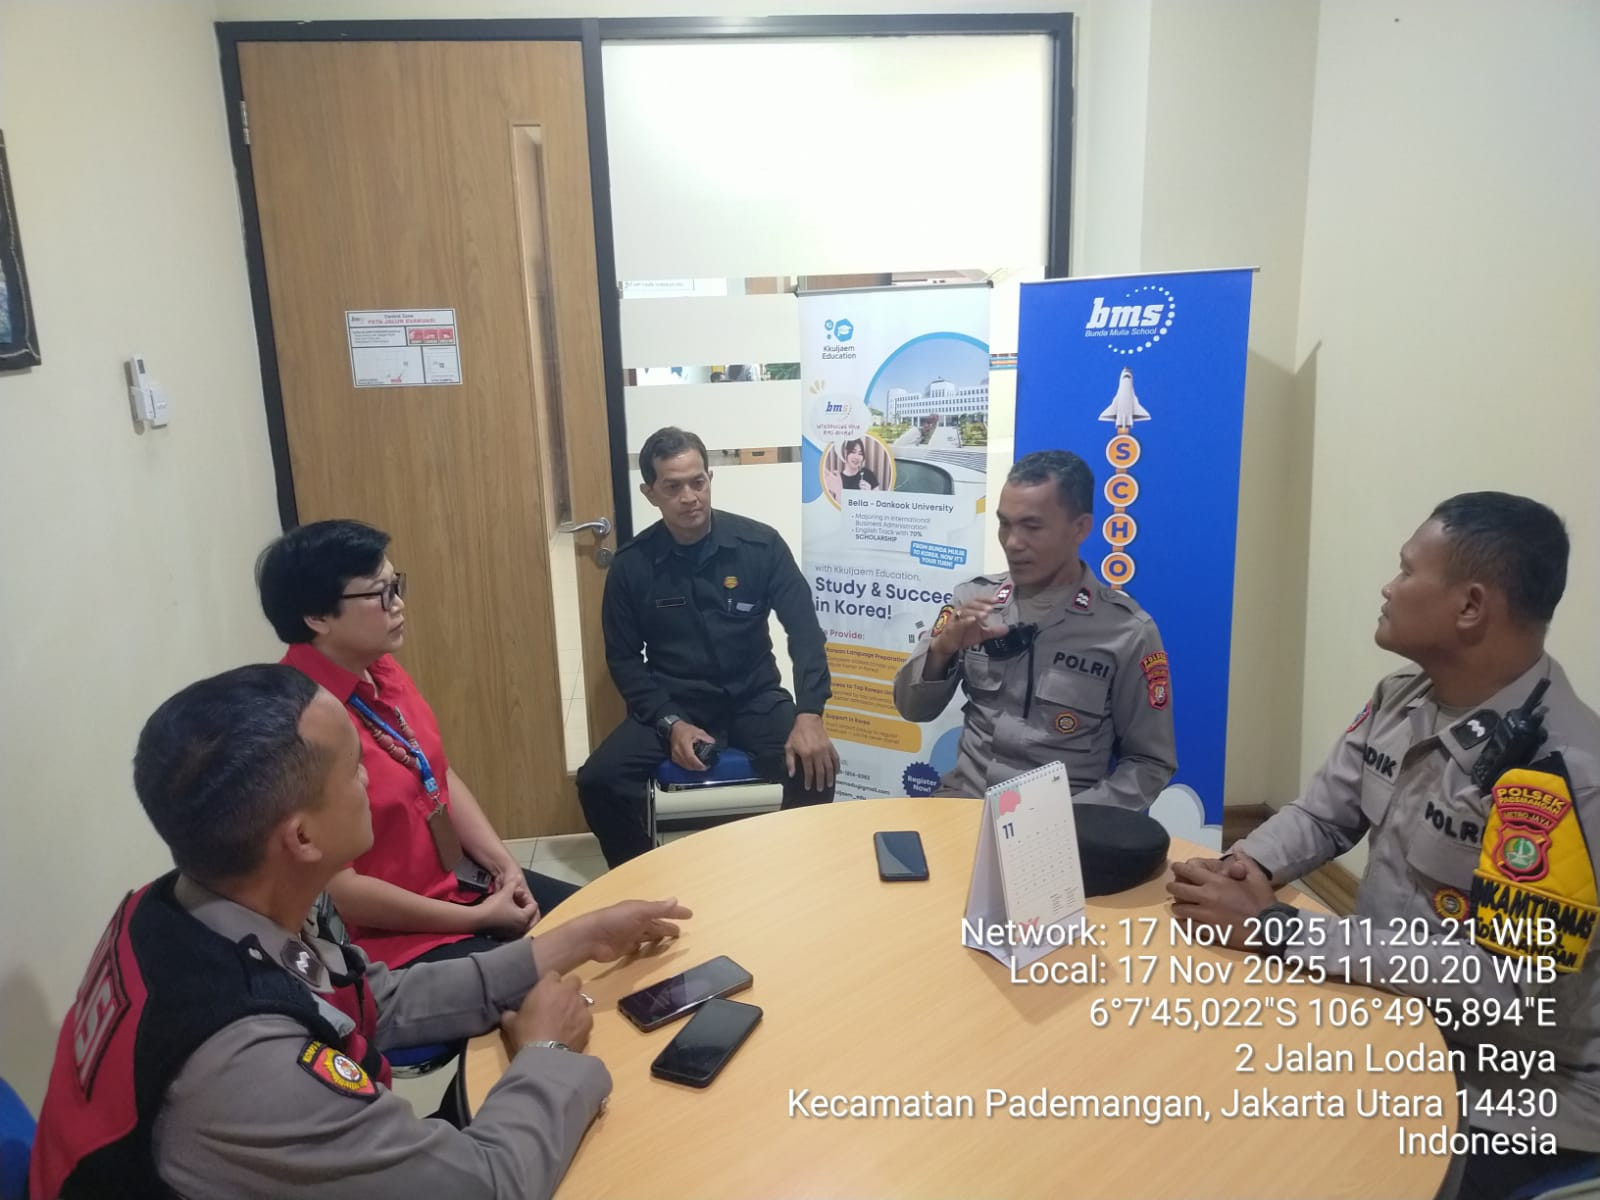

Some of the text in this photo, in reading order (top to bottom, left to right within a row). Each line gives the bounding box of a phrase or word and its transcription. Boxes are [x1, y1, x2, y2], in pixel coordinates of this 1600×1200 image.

[1086, 297, 1164, 328] bms
[1085, 327, 1157, 337] Bunda Mulia School
[821, 352, 857, 360] Education
[848, 499, 869, 507] Bella
[875, 500, 910, 510] Dankook
[911, 502, 954, 514] University
[855, 527, 878, 535] English
[909, 530, 923, 538] 70%
[855, 534, 897, 542] SCHOLARSHIP
[815, 564, 832, 573] with
[815, 577, 867, 598] Study
[871, 582, 881, 597] &
[815, 597, 893, 619] in Korea!
[830, 628, 865, 640] Provide:
[1053, 651, 1110, 678] POLRI
[907, 775, 937, 787] Register
[912, 783, 932, 793] Now!
[1496, 787, 1566, 809] POLSEK
[1002, 822, 1015, 839] 11
